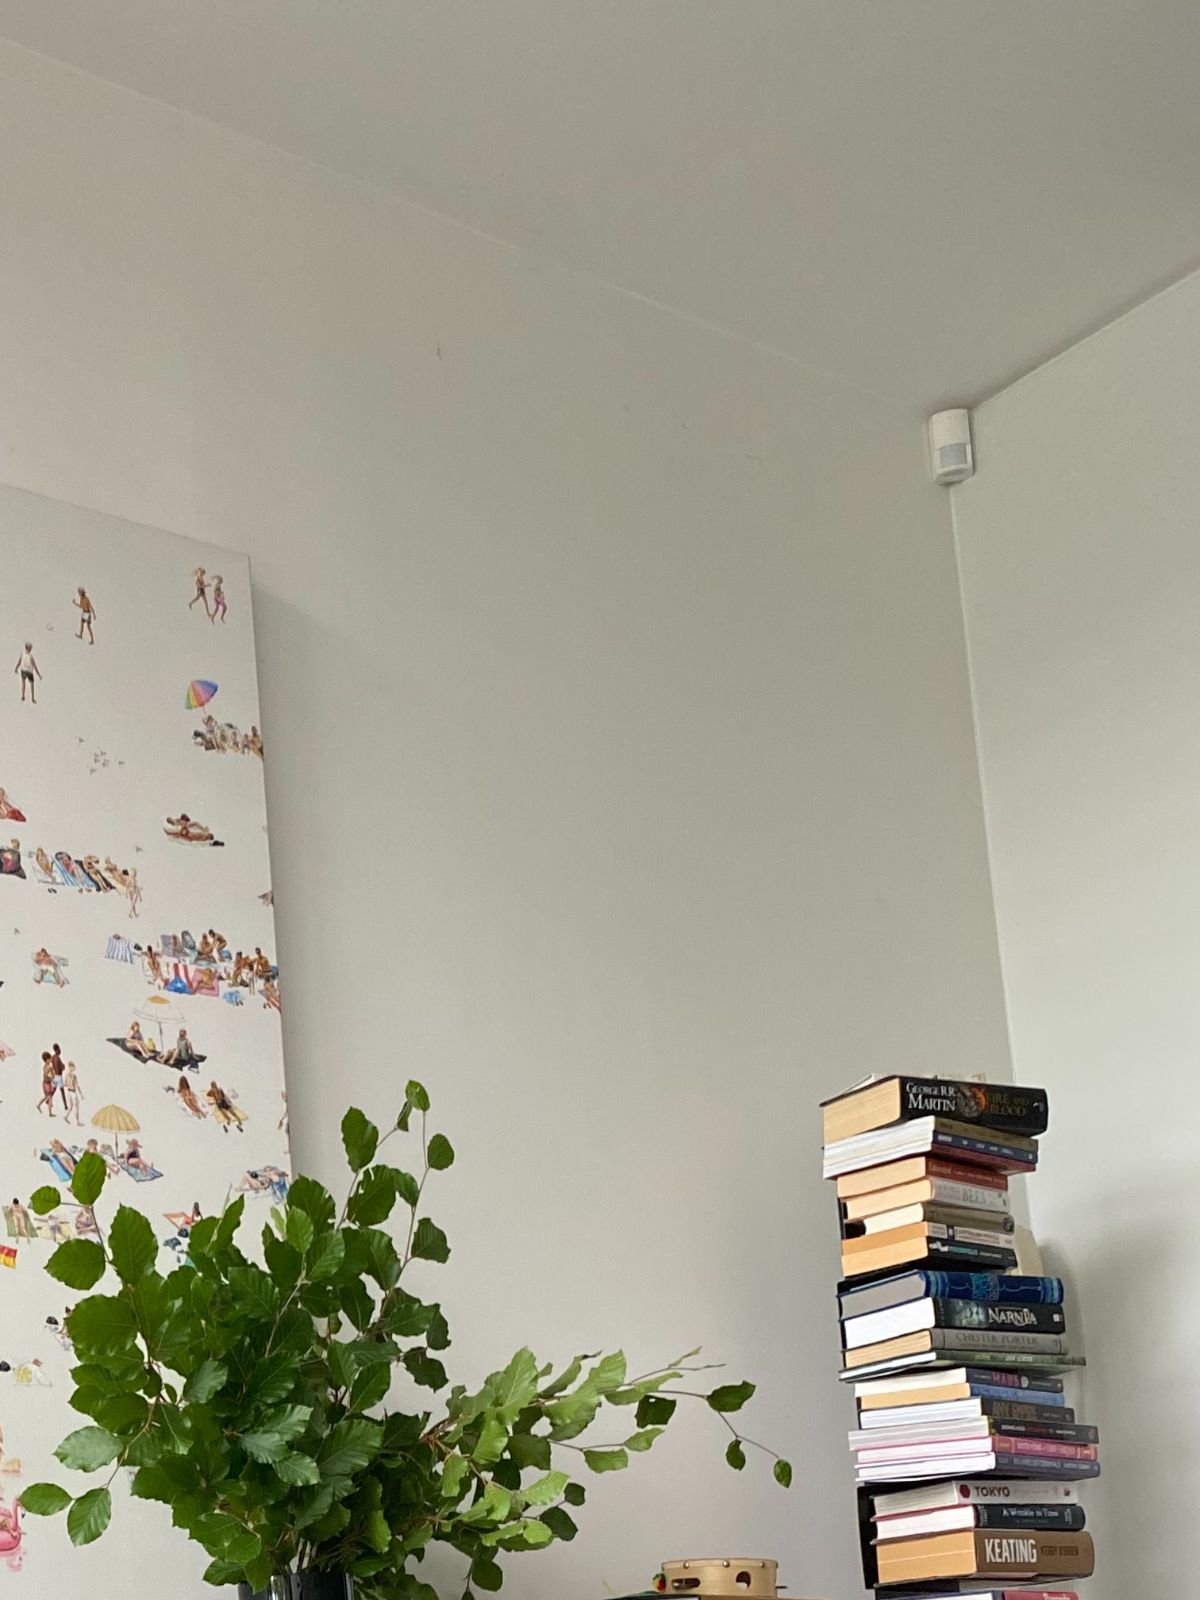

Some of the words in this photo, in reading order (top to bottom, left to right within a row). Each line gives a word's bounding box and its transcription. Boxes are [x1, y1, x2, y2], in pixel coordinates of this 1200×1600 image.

[906, 1083, 939, 1095] GEORGE
[908, 1093, 956, 1112] MARTIN
[987, 1306, 1038, 1326] NARNIA
[974, 1486, 1010, 1497] TOKYO
[984, 1538, 1038, 1563] KEATING
